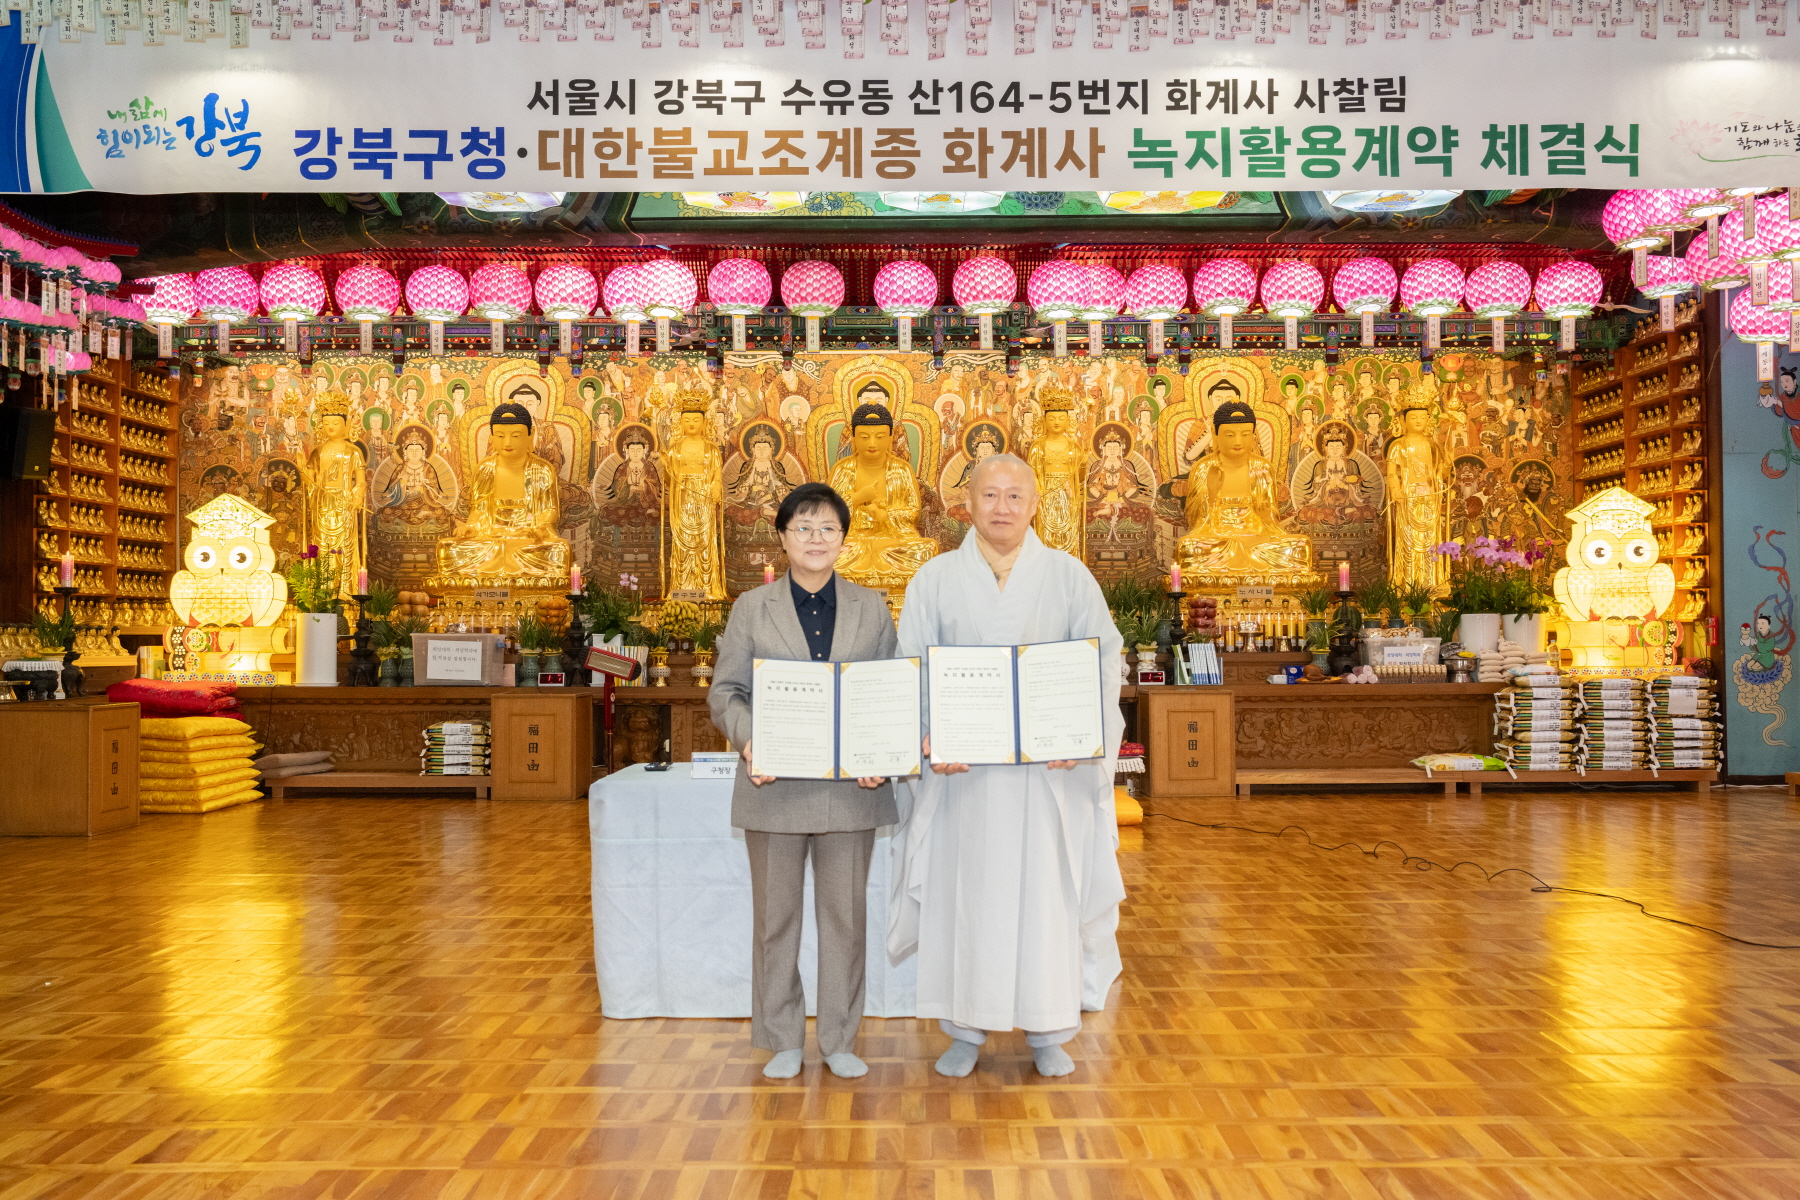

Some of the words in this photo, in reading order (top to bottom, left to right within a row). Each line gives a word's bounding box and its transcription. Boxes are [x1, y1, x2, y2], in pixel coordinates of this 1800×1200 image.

[527, 79, 636, 115] 서울시
[654, 79, 766, 115] 강북구
[781, 79, 893, 115] 수유동
[908, 79, 1148, 115] 산164-5번지
[1166, 78, 1279, 114] 화계사
[1294, 76, 1406, 113] 사찰림
[175, 93, 262, 171] 강북
[943, 127, 1106, 179] 화계사
[1128, 125, 1459, 179] 녹지활용계약
[1481, 123, 1639, 178] 체결식
[711, 767, 731, 775] 구청장
